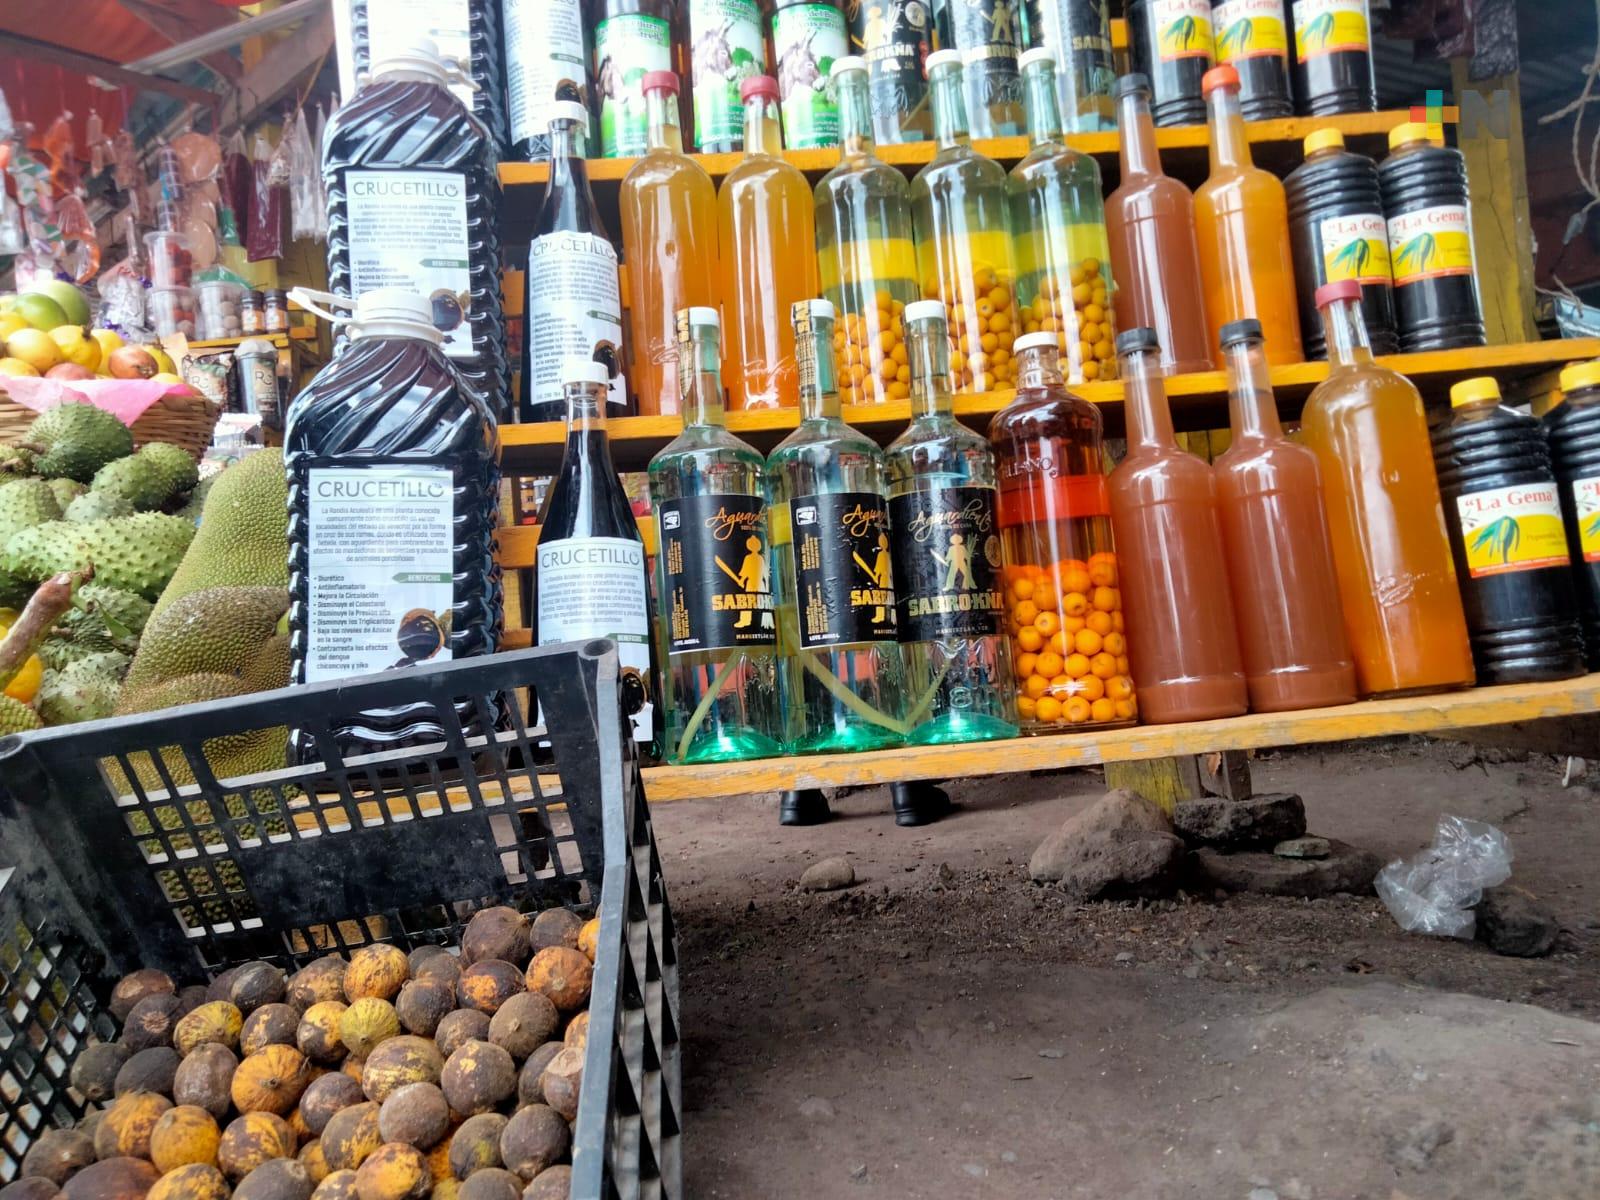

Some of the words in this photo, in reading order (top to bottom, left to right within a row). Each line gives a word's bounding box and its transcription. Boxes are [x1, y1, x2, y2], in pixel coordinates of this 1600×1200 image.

[353, 181, 459, 198] CRUCETILLO
[317, 481, 445, 498] CRUCETILLO
[541, 547, 641, 569] CRUCETILLO
